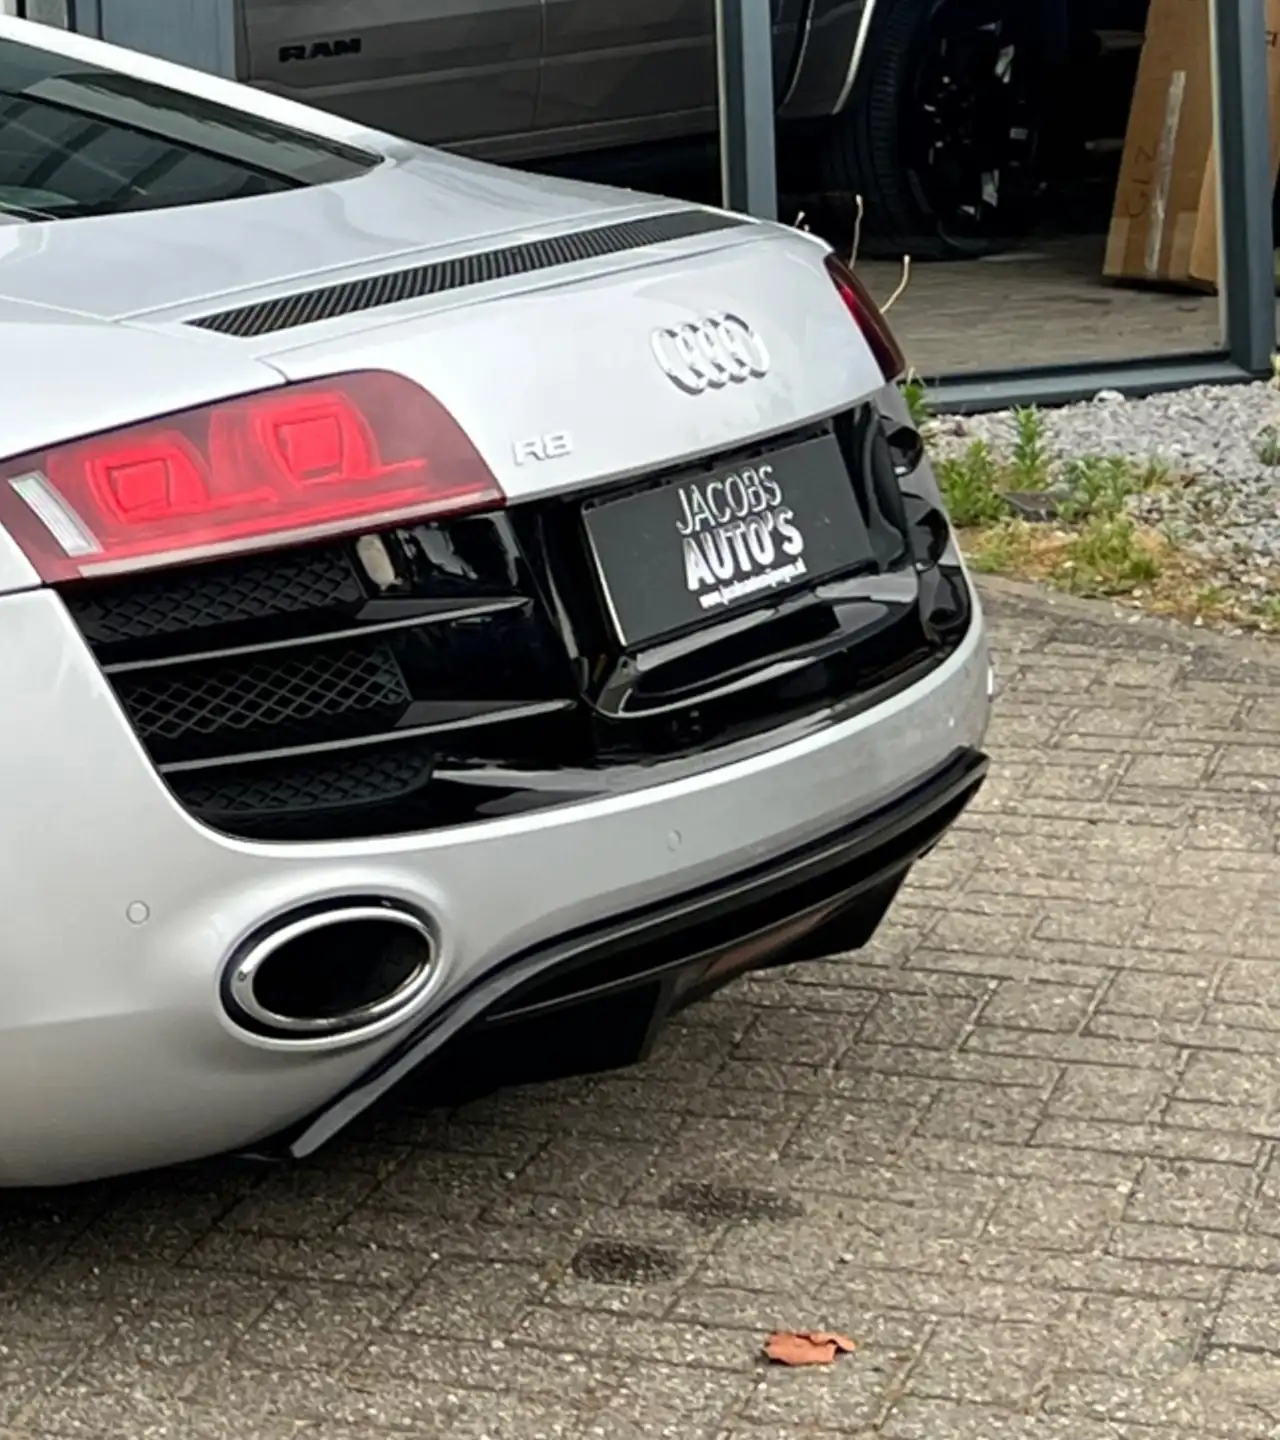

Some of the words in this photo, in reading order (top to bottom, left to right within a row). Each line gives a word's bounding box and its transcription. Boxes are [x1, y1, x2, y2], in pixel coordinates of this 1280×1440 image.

[279, 38, 362, 62] RAM
[676, 465, 782, 535] JACOBS
[683, 506, 804, 591] AUTO'S
